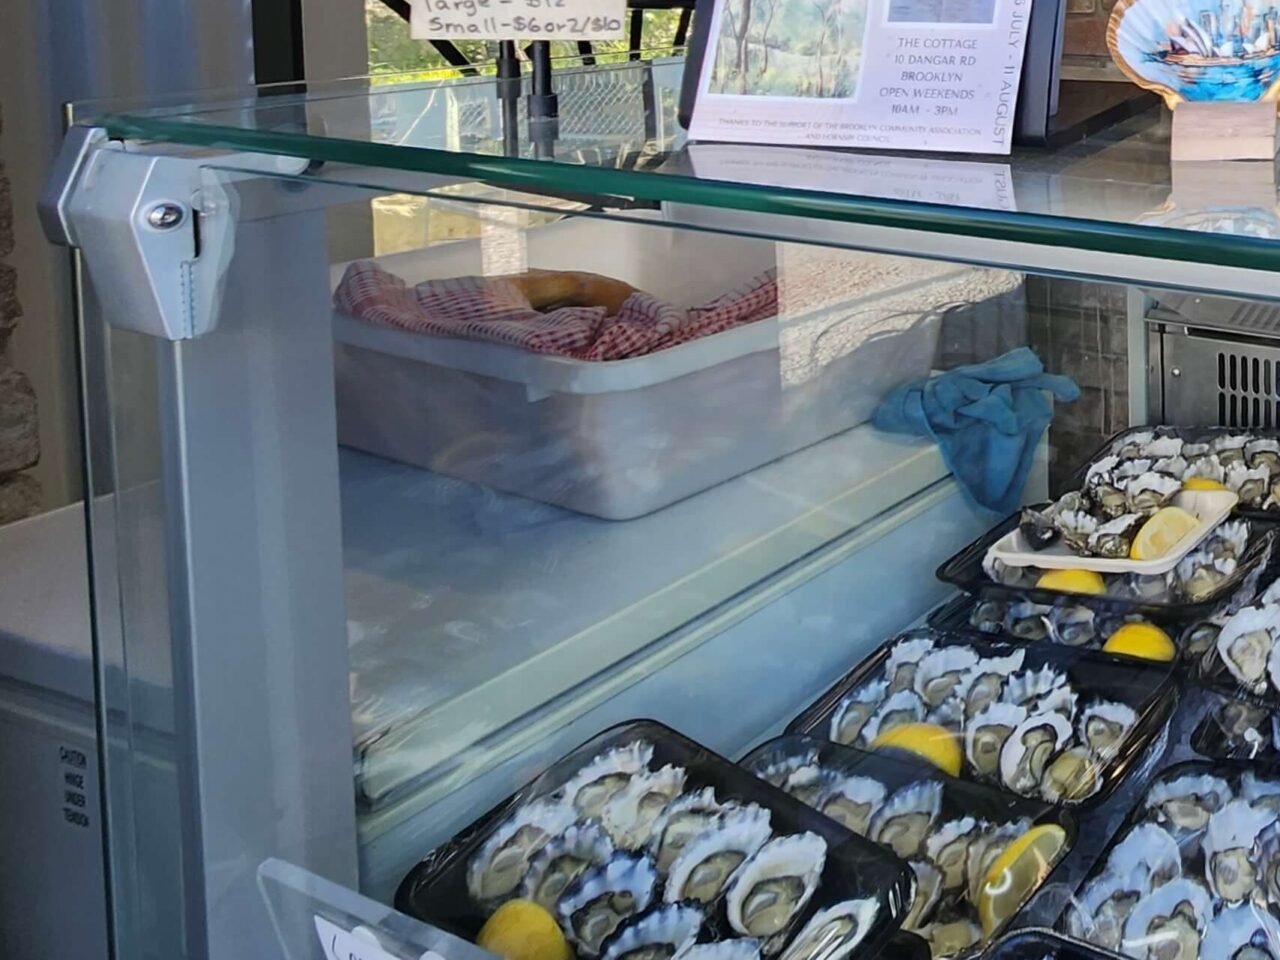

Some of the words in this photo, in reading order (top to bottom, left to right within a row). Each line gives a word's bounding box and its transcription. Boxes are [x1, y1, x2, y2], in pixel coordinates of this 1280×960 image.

[1008, 11, 1023, 48] JULY
[898, 37, 920, 48] THE
[923, 38, 978, 49] COTTAGE
[895, 54, 905, 64] 10
[908, 54, 956, 65] DANGAR
[959, 55, 977, 66] RD
[900, 71, 963, 82] BROOKLYN
[879, 87, 910, 98] OPEN
[912, 88, 976, 100] WEEKENDS
[891, 104, 921, 114] 10AM
[933, 105, 959, 117] 3PM
[992, 80, 1012, 147] AUGUST
